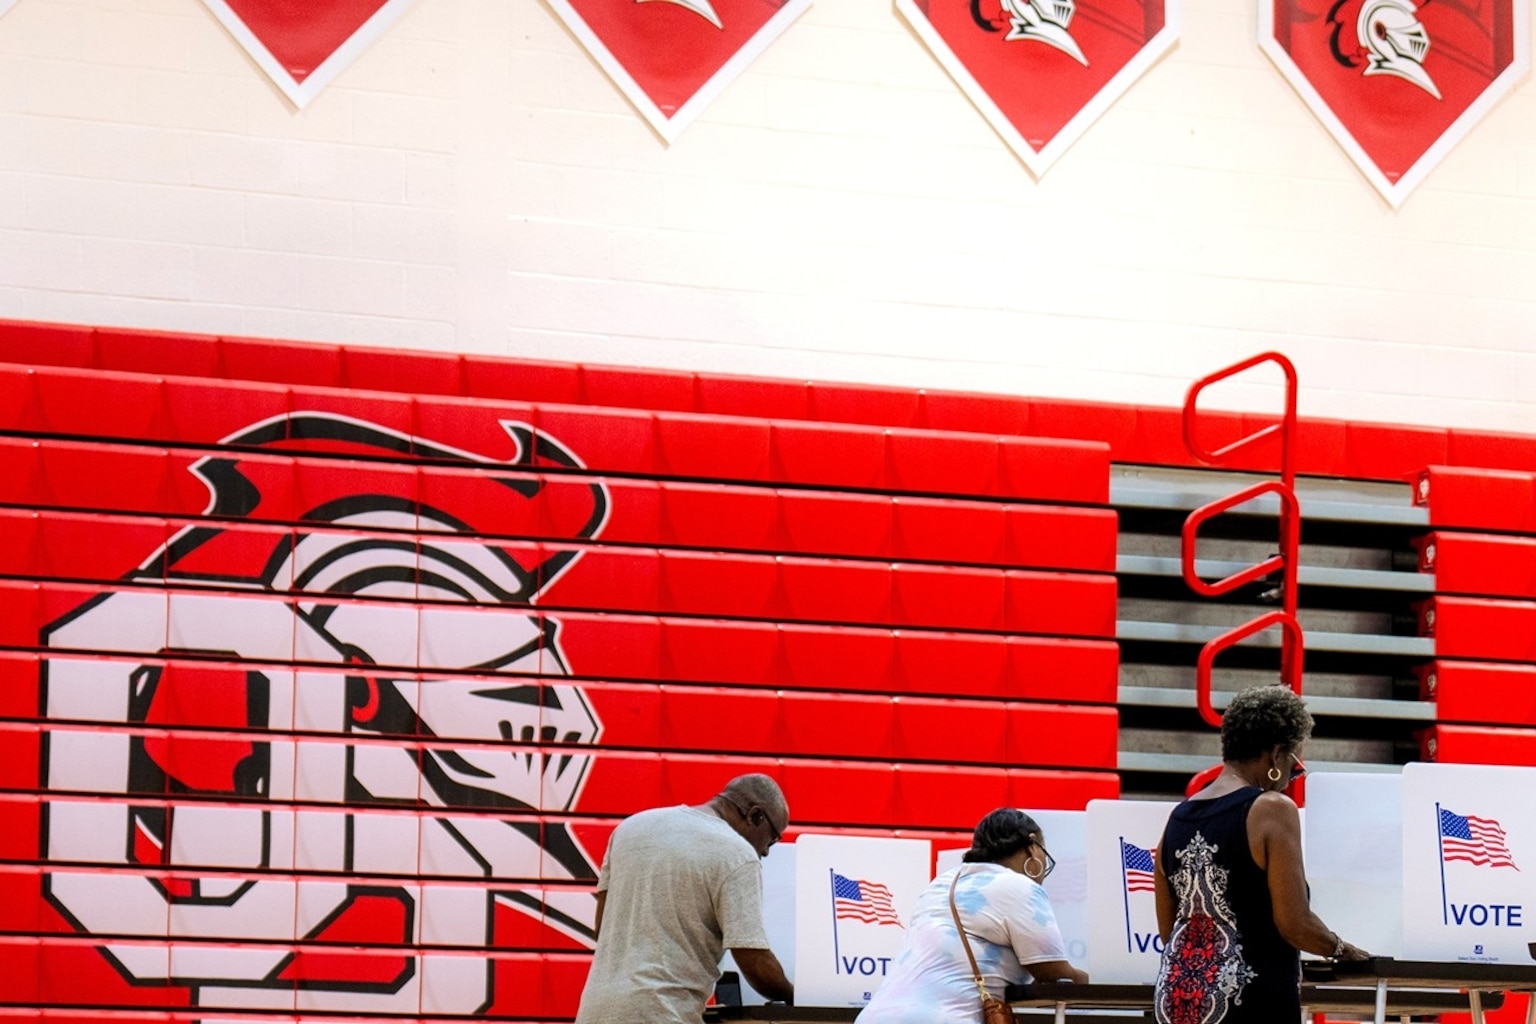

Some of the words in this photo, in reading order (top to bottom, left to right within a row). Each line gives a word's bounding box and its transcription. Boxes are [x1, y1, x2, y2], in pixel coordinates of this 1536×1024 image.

[1450, 903, 1523, 927] VOTE
[1134, 932, 1164, 953] VO
[842, 955, 892, 977] VOT
